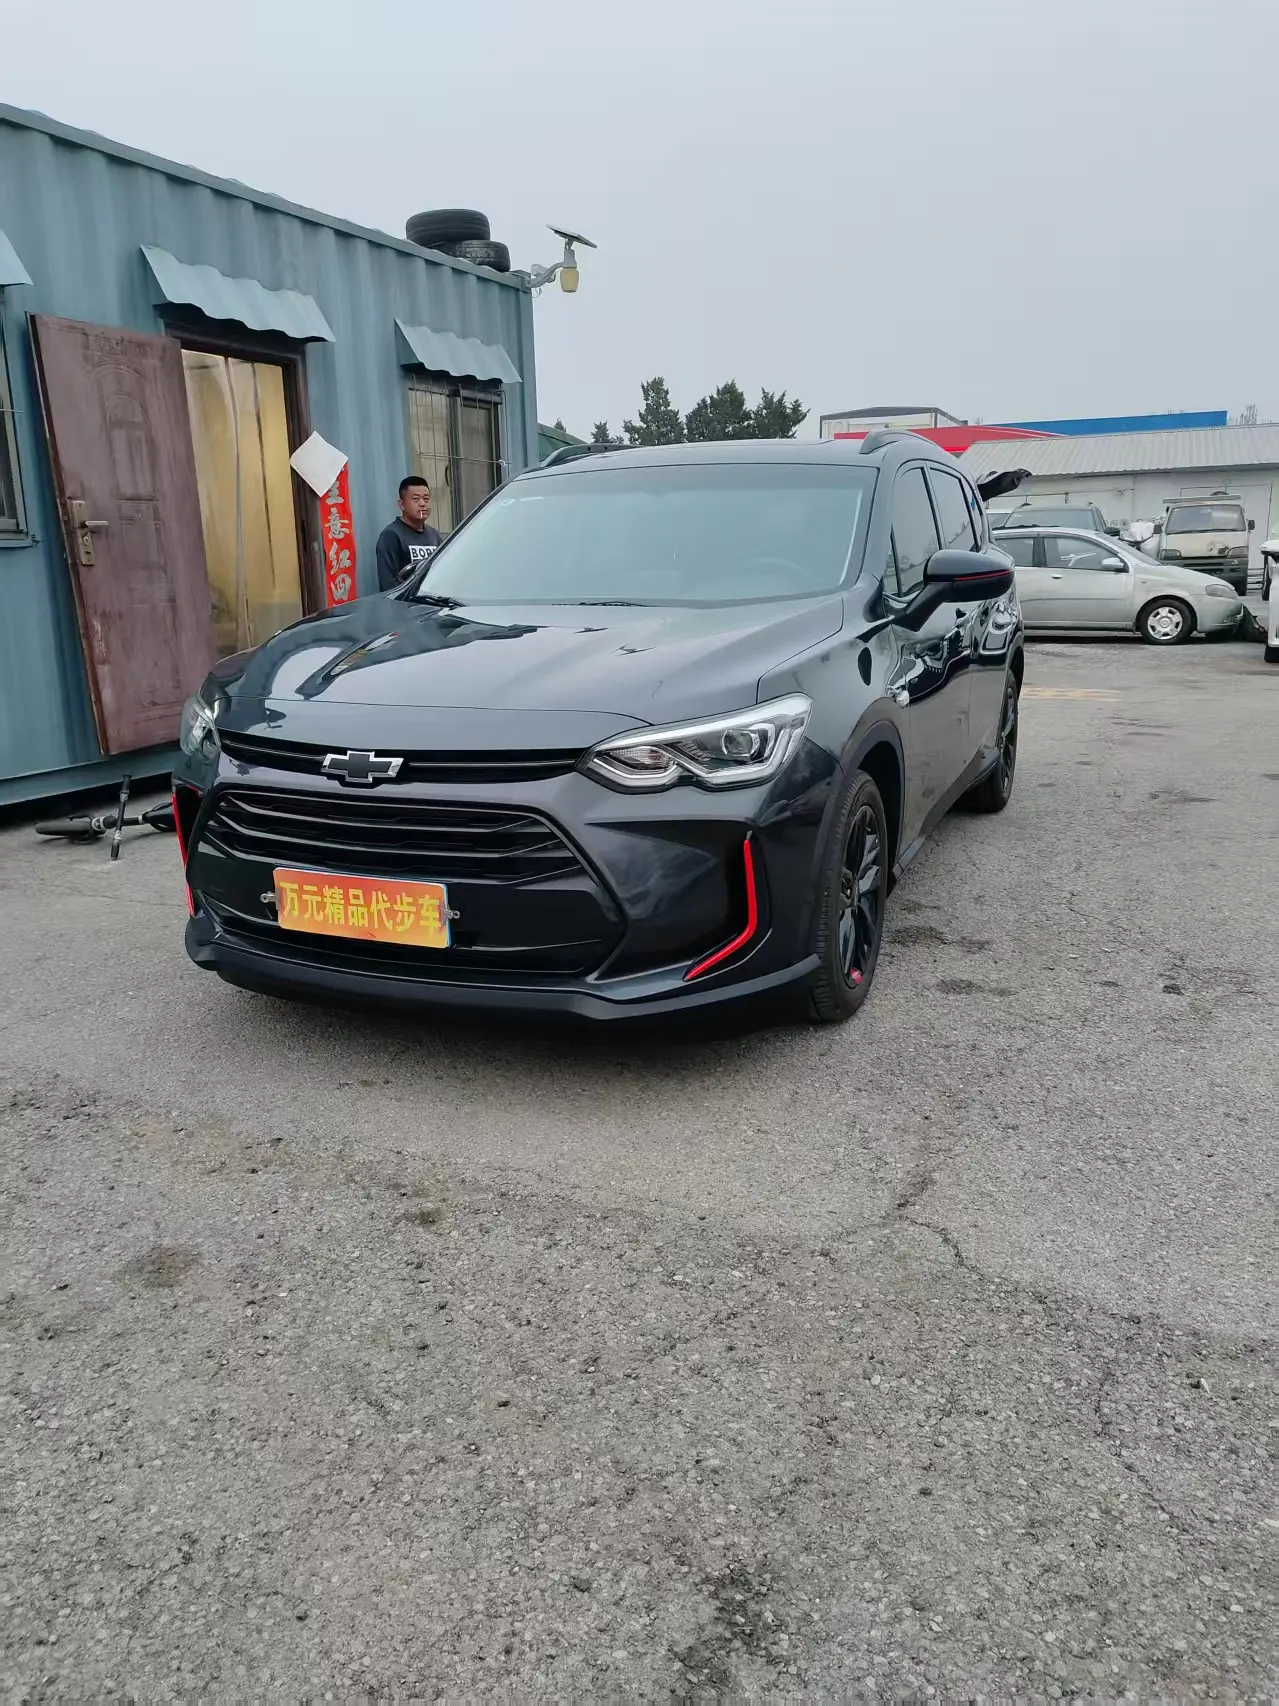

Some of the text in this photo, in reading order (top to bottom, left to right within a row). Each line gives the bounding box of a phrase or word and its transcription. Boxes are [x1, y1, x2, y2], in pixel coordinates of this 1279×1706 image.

[280, 882, 441, 937] 万元精品代步车
